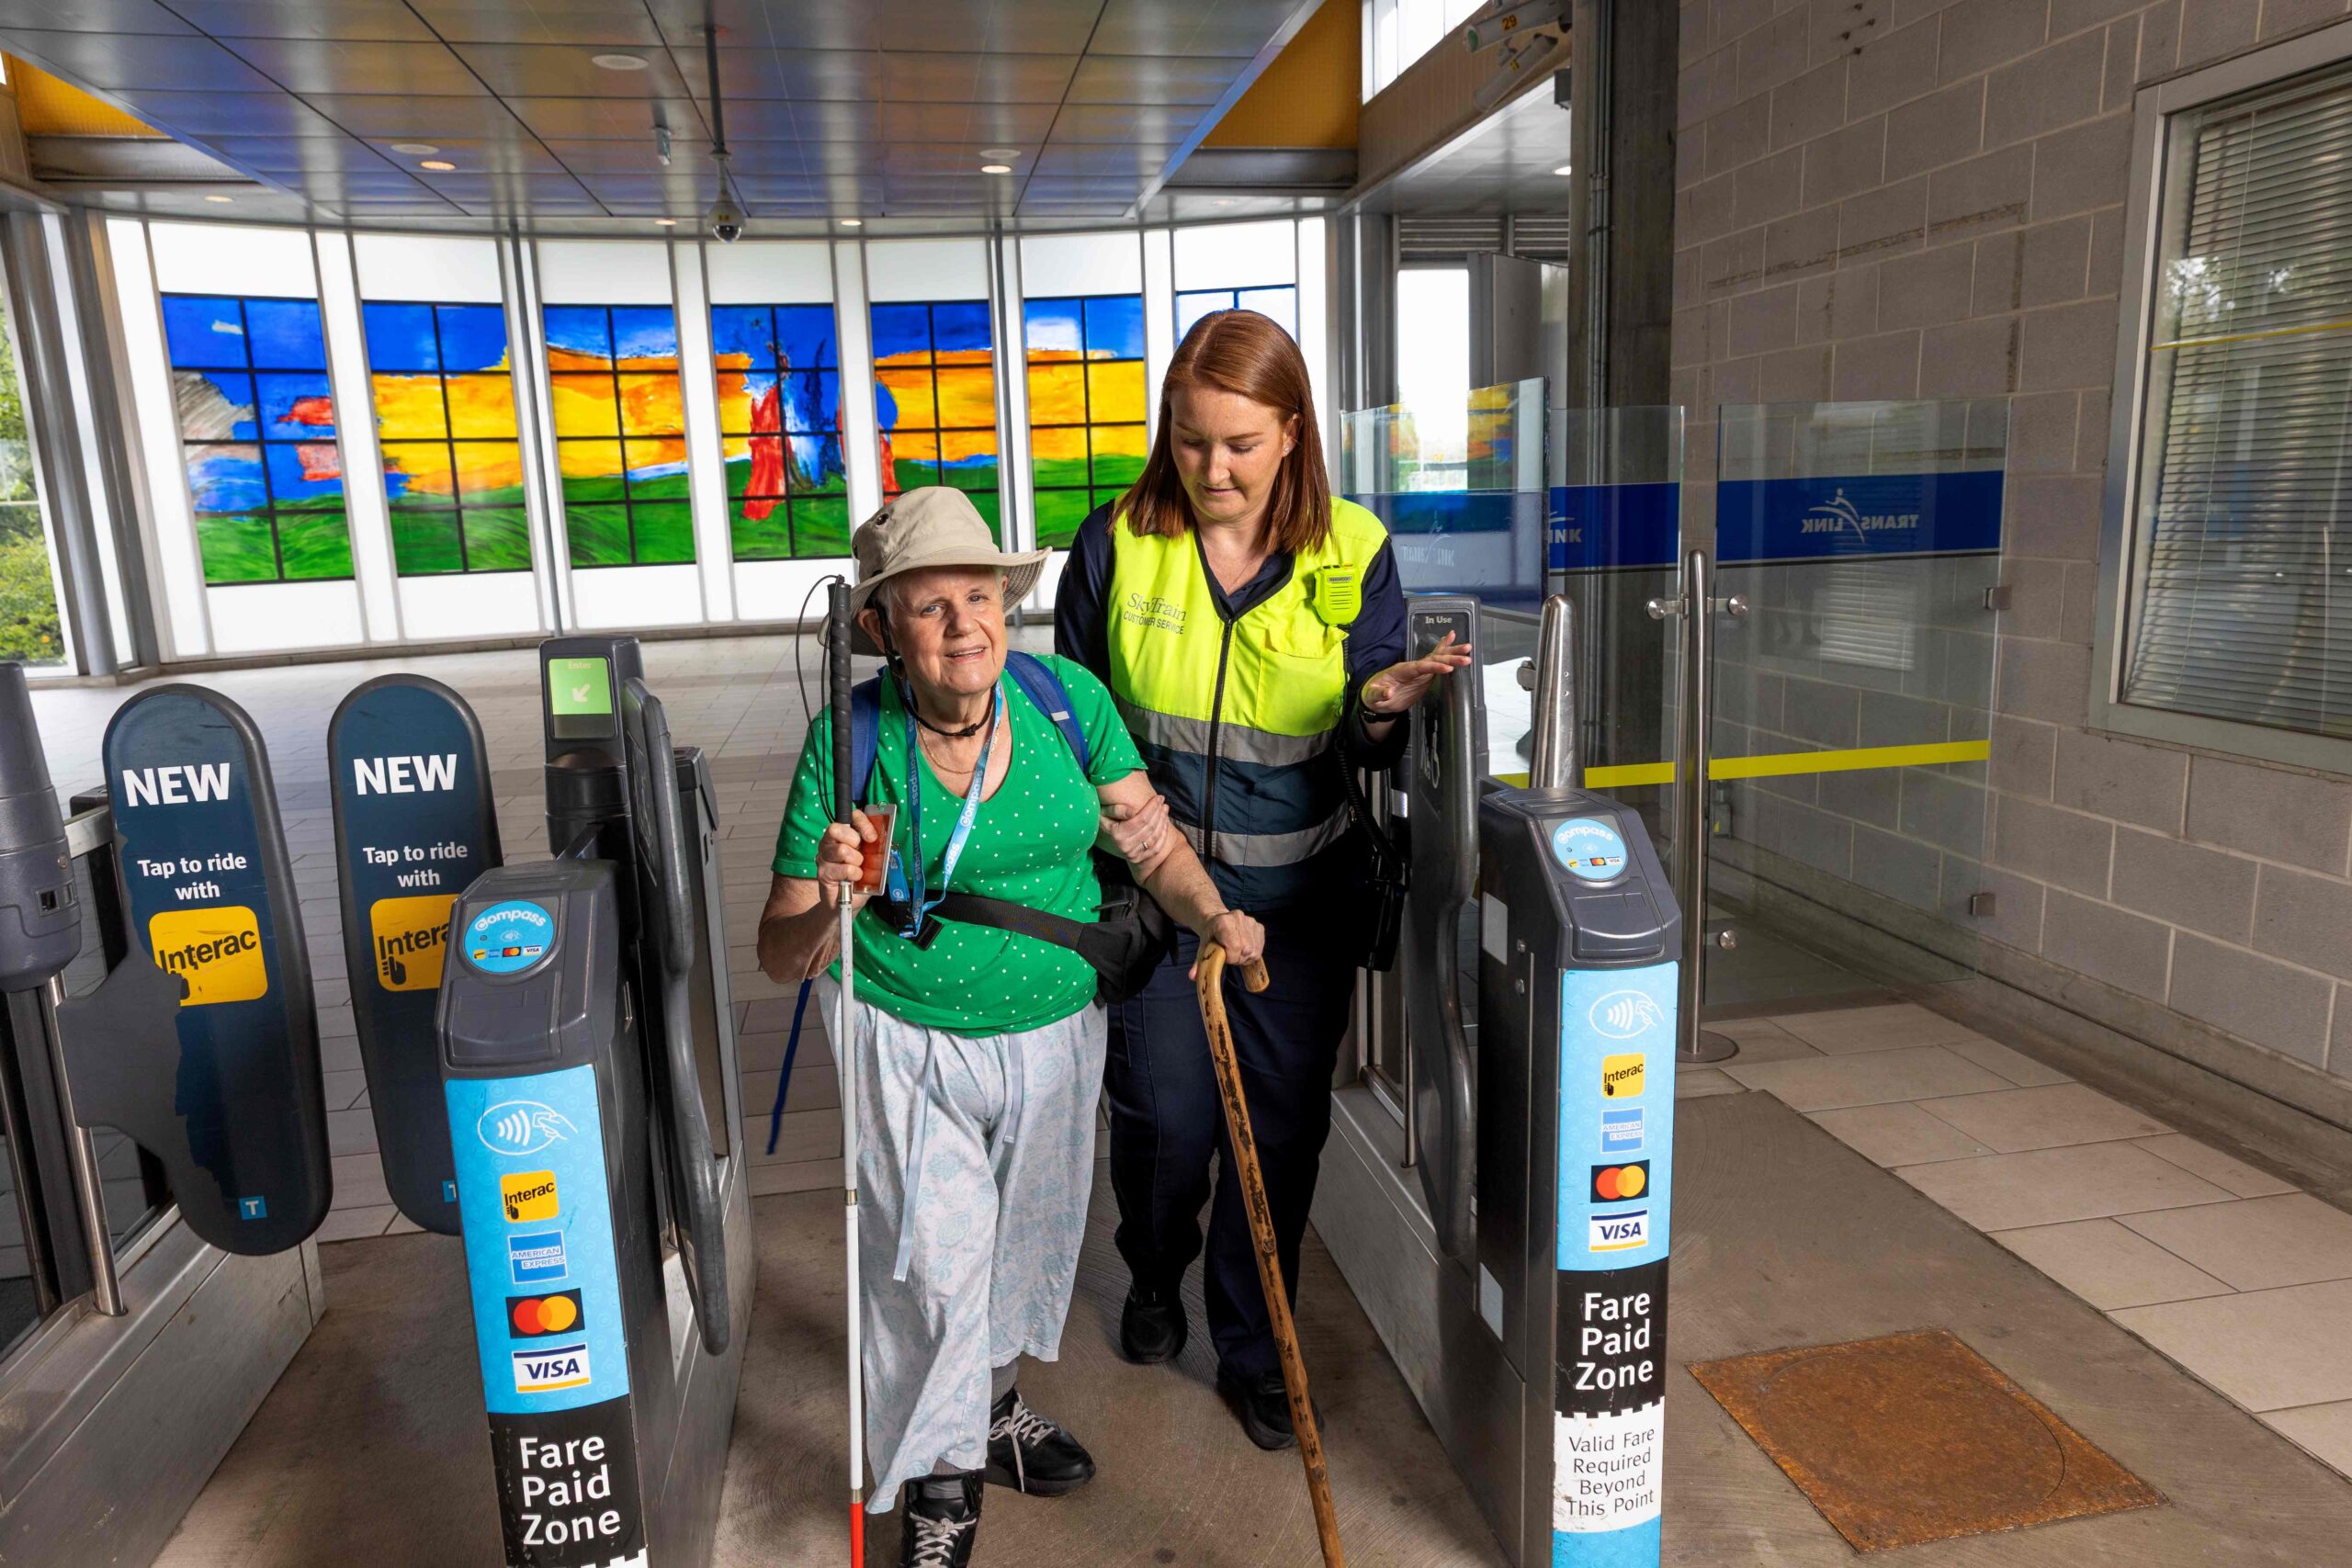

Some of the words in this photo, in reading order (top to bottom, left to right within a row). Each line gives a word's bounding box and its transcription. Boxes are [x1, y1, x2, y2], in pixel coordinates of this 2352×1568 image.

[1502, 15, 1518, 30] 29
[1548, 528, 1582, 544] INK
[1126, 592, 1187, 621] SkyTrain
[1124, 610, 1156, 626] CUSTOMER
[1156, 617, 1184, 635] SERVICE
[1425, 615, 1434, 624] In
[1436, 615, 1453, 624] Use
[568, 660, 592, 670] Enter
[122, 762, 230, 807] NEW
[353, 753, 458, 795] NEW
[960, 770, 983, 827] Compass
[1557, 827, 1613, 844] Compass
[138, 860, 175, 879] Tap
[180, 857, 202, 874] to
[208, 852, 247, 872] ride
[362, 847, 399, 866] Tap
[403, 845, 424, 862] to
[429, 841, 469, 860] ride
[175, 881, 220, 900] with
[397, 869, 441, 887] with
[475, 909, 546, 931] Compass
[159, 930, 257, 975] Interac
[379, 923, 449, 960] Inter
[1603, 1064, 1644, 1084] Interac
[1602, 1122, 1640, 1132] AMERICAN
[1611, 1131, 1644, 1139] EXPRESS
[504, 1182, 555, 1207] Interac
[245, 1201, 258, 1215] T
[1599, 1222, 1642, 1240] VISA
[512, 1247, 560, 1258] AMERICAN
[523, 1257, 565, 1268] EXPRESS
[1584, 1292, 1650, 1321] Fare
[1582, 1318, 1650, 1356] Paid
[522, 1358, 581, 1380] VISA
[1576, 1360, 1653, 1391] Zone
[519, 1435, 605, 1469] Fare
[1568, 1435, 1614, 1452] Valid
[1623, 1428, 1655, 1448] Fare
[1574, 1447, 1651, 1476] Required
[521, 1464, 611, 1507] Paid
[1580, 1471, 1645, 1497] Beyond
[1566, 1499, 1605, 1516] This
[1614, 1489, 1655, 1513] Point
[520, 1509, 620, 1545] Zone
